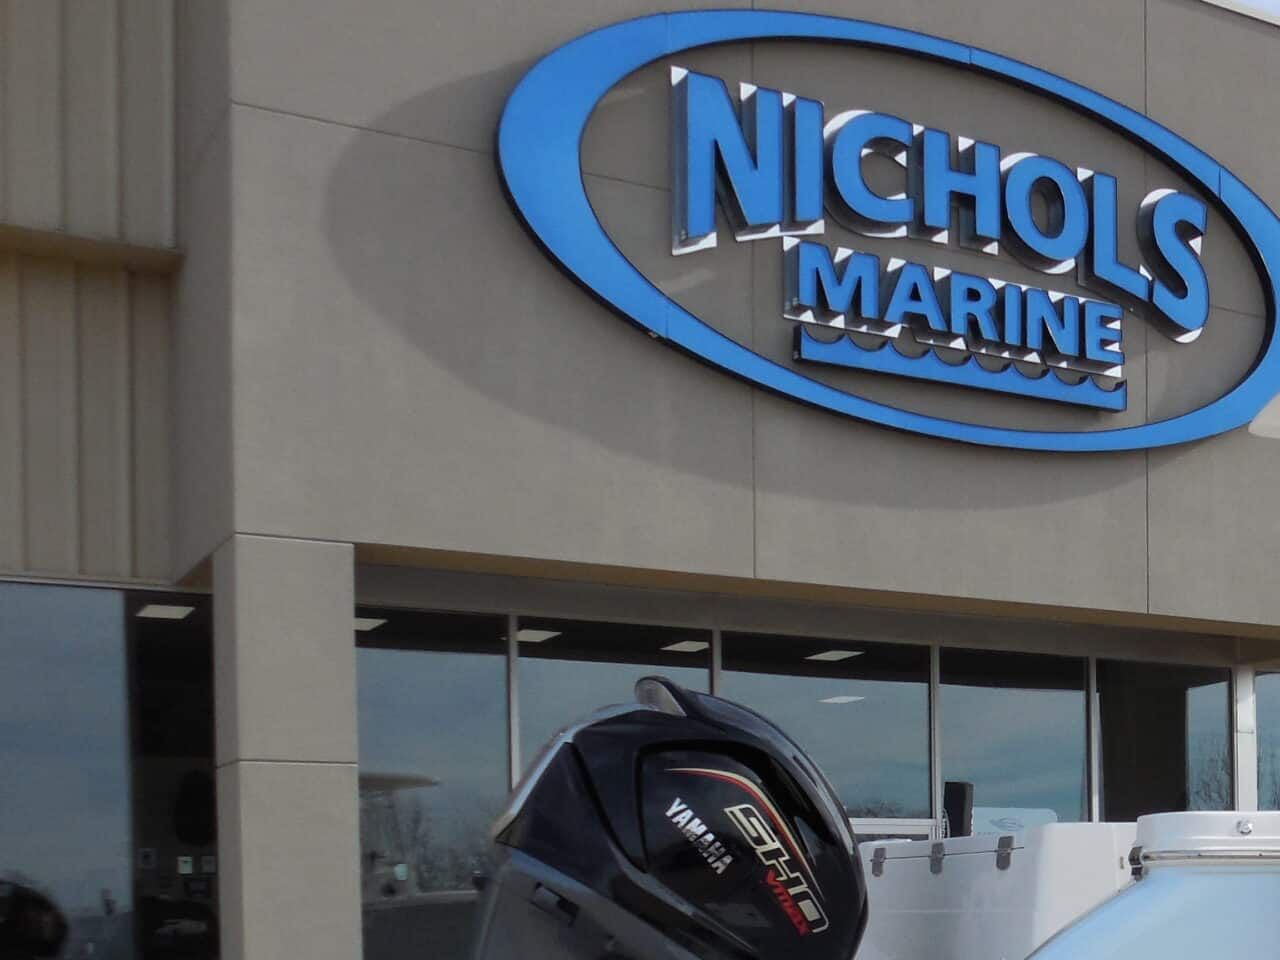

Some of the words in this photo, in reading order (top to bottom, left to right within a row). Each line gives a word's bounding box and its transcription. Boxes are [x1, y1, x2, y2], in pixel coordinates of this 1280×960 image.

[675, 66, 1210, 341] NICHOLS
[787, 238, 1124, 373] MARINE
[665, 797, 735, 875] YAMAHA
